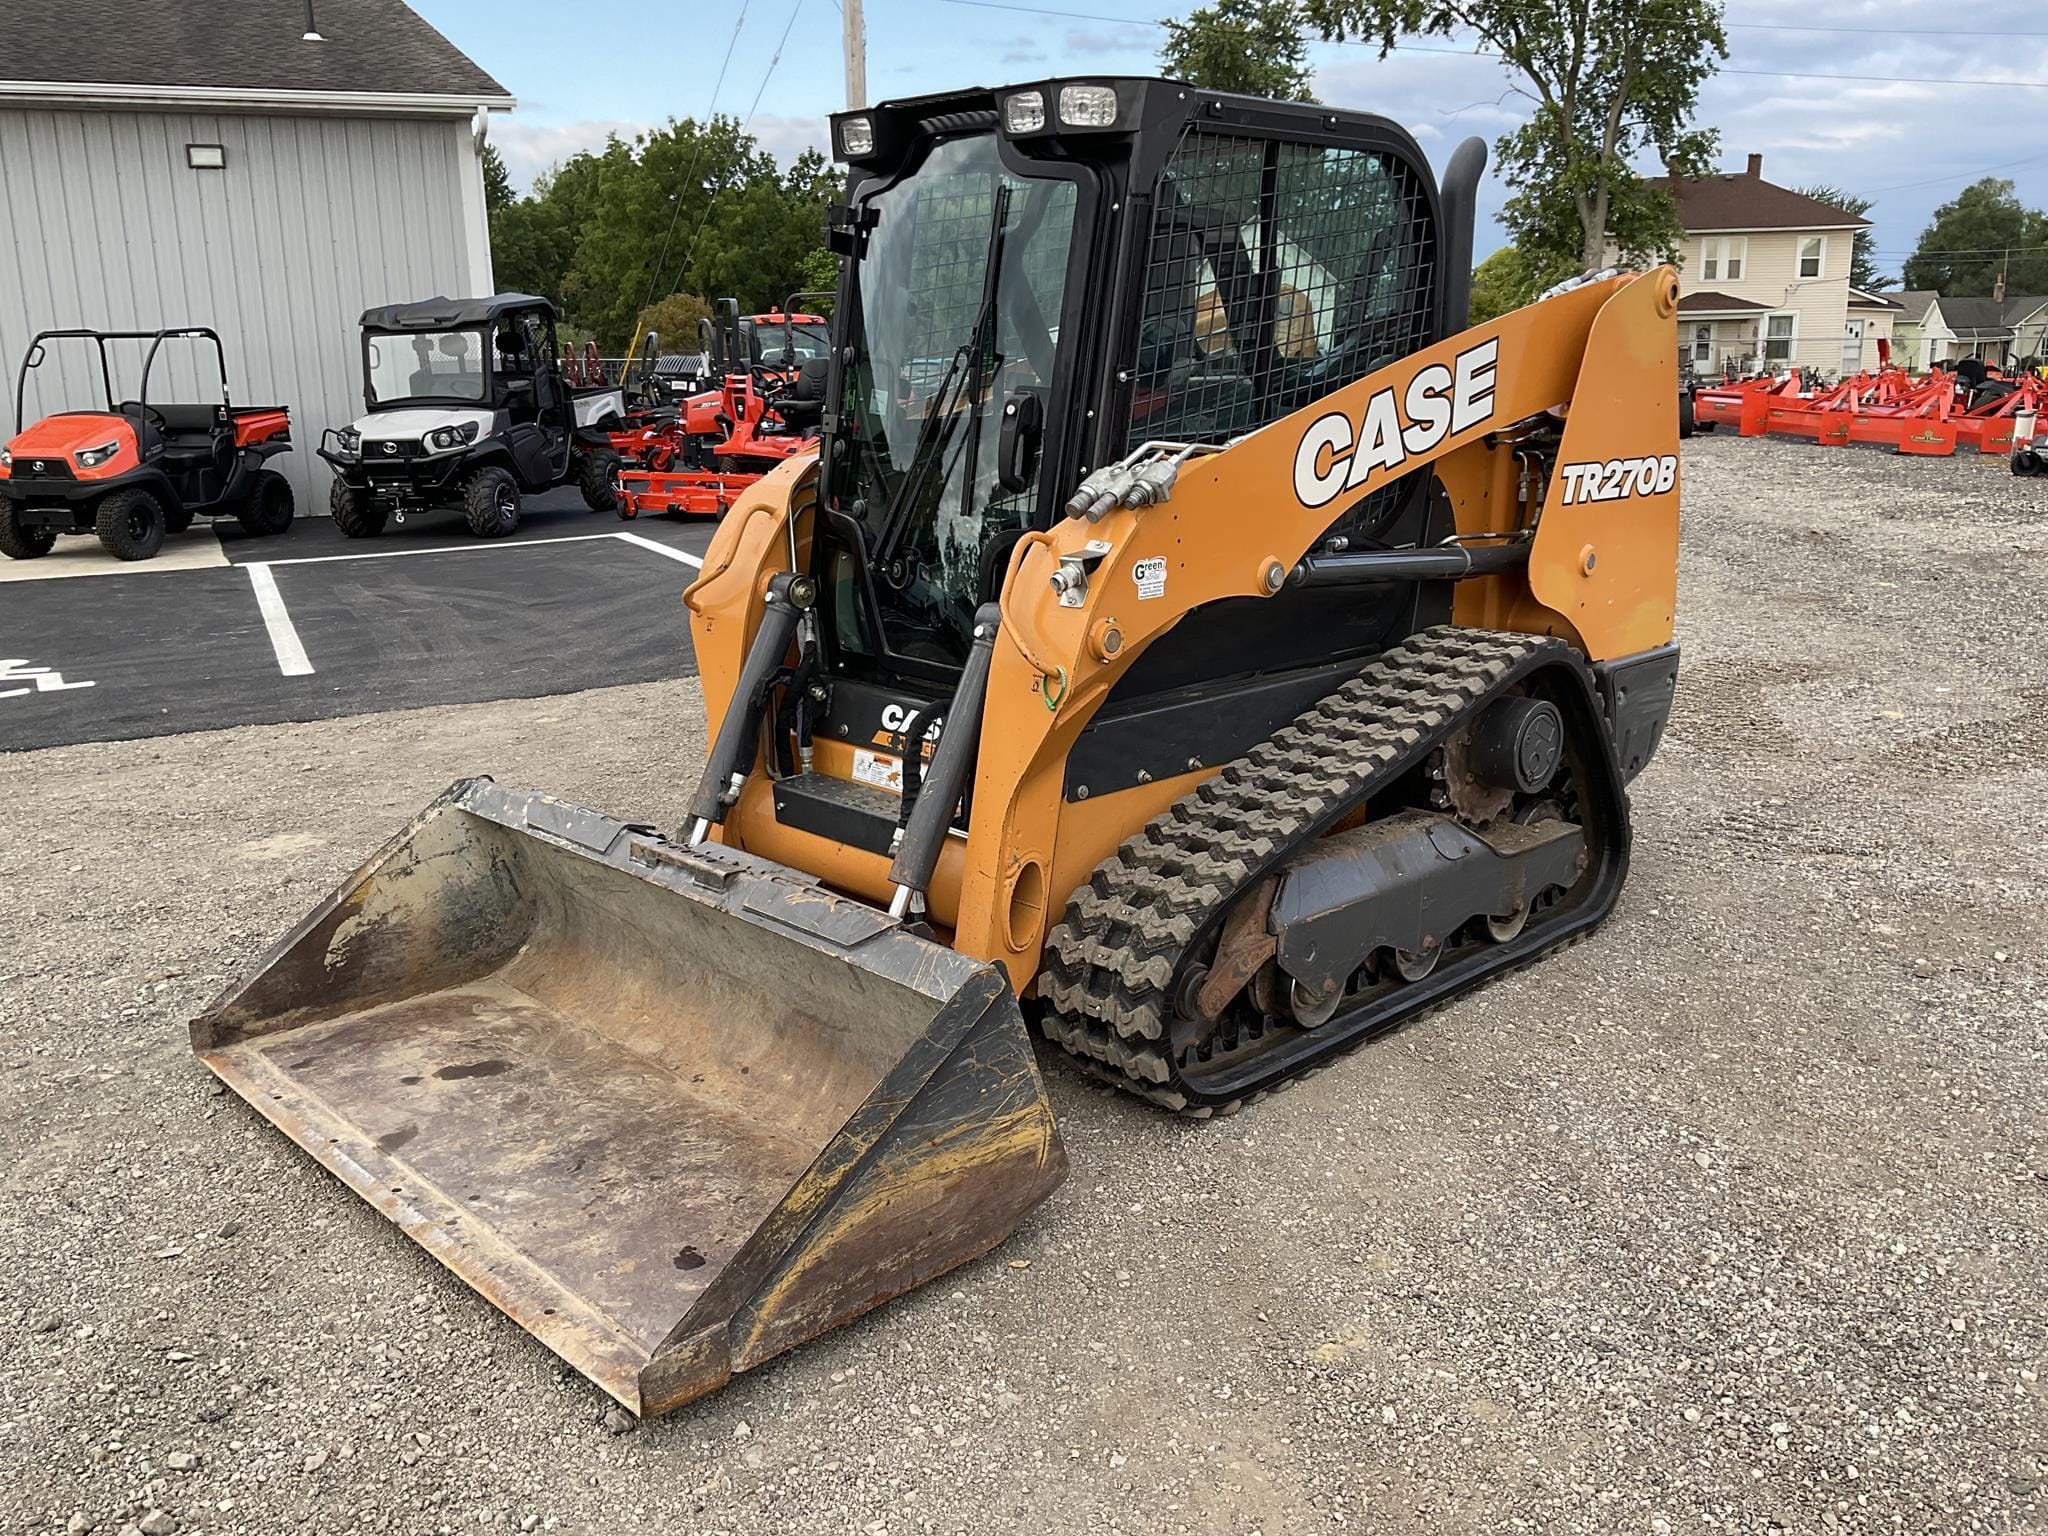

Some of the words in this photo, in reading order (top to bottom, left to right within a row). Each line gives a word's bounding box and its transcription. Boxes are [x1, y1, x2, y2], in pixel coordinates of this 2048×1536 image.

[1293, 336, 1499, 509] CASE
[1561, 455, 1678, 506] TR270B
[1135, 561, 1163, 580] Green
